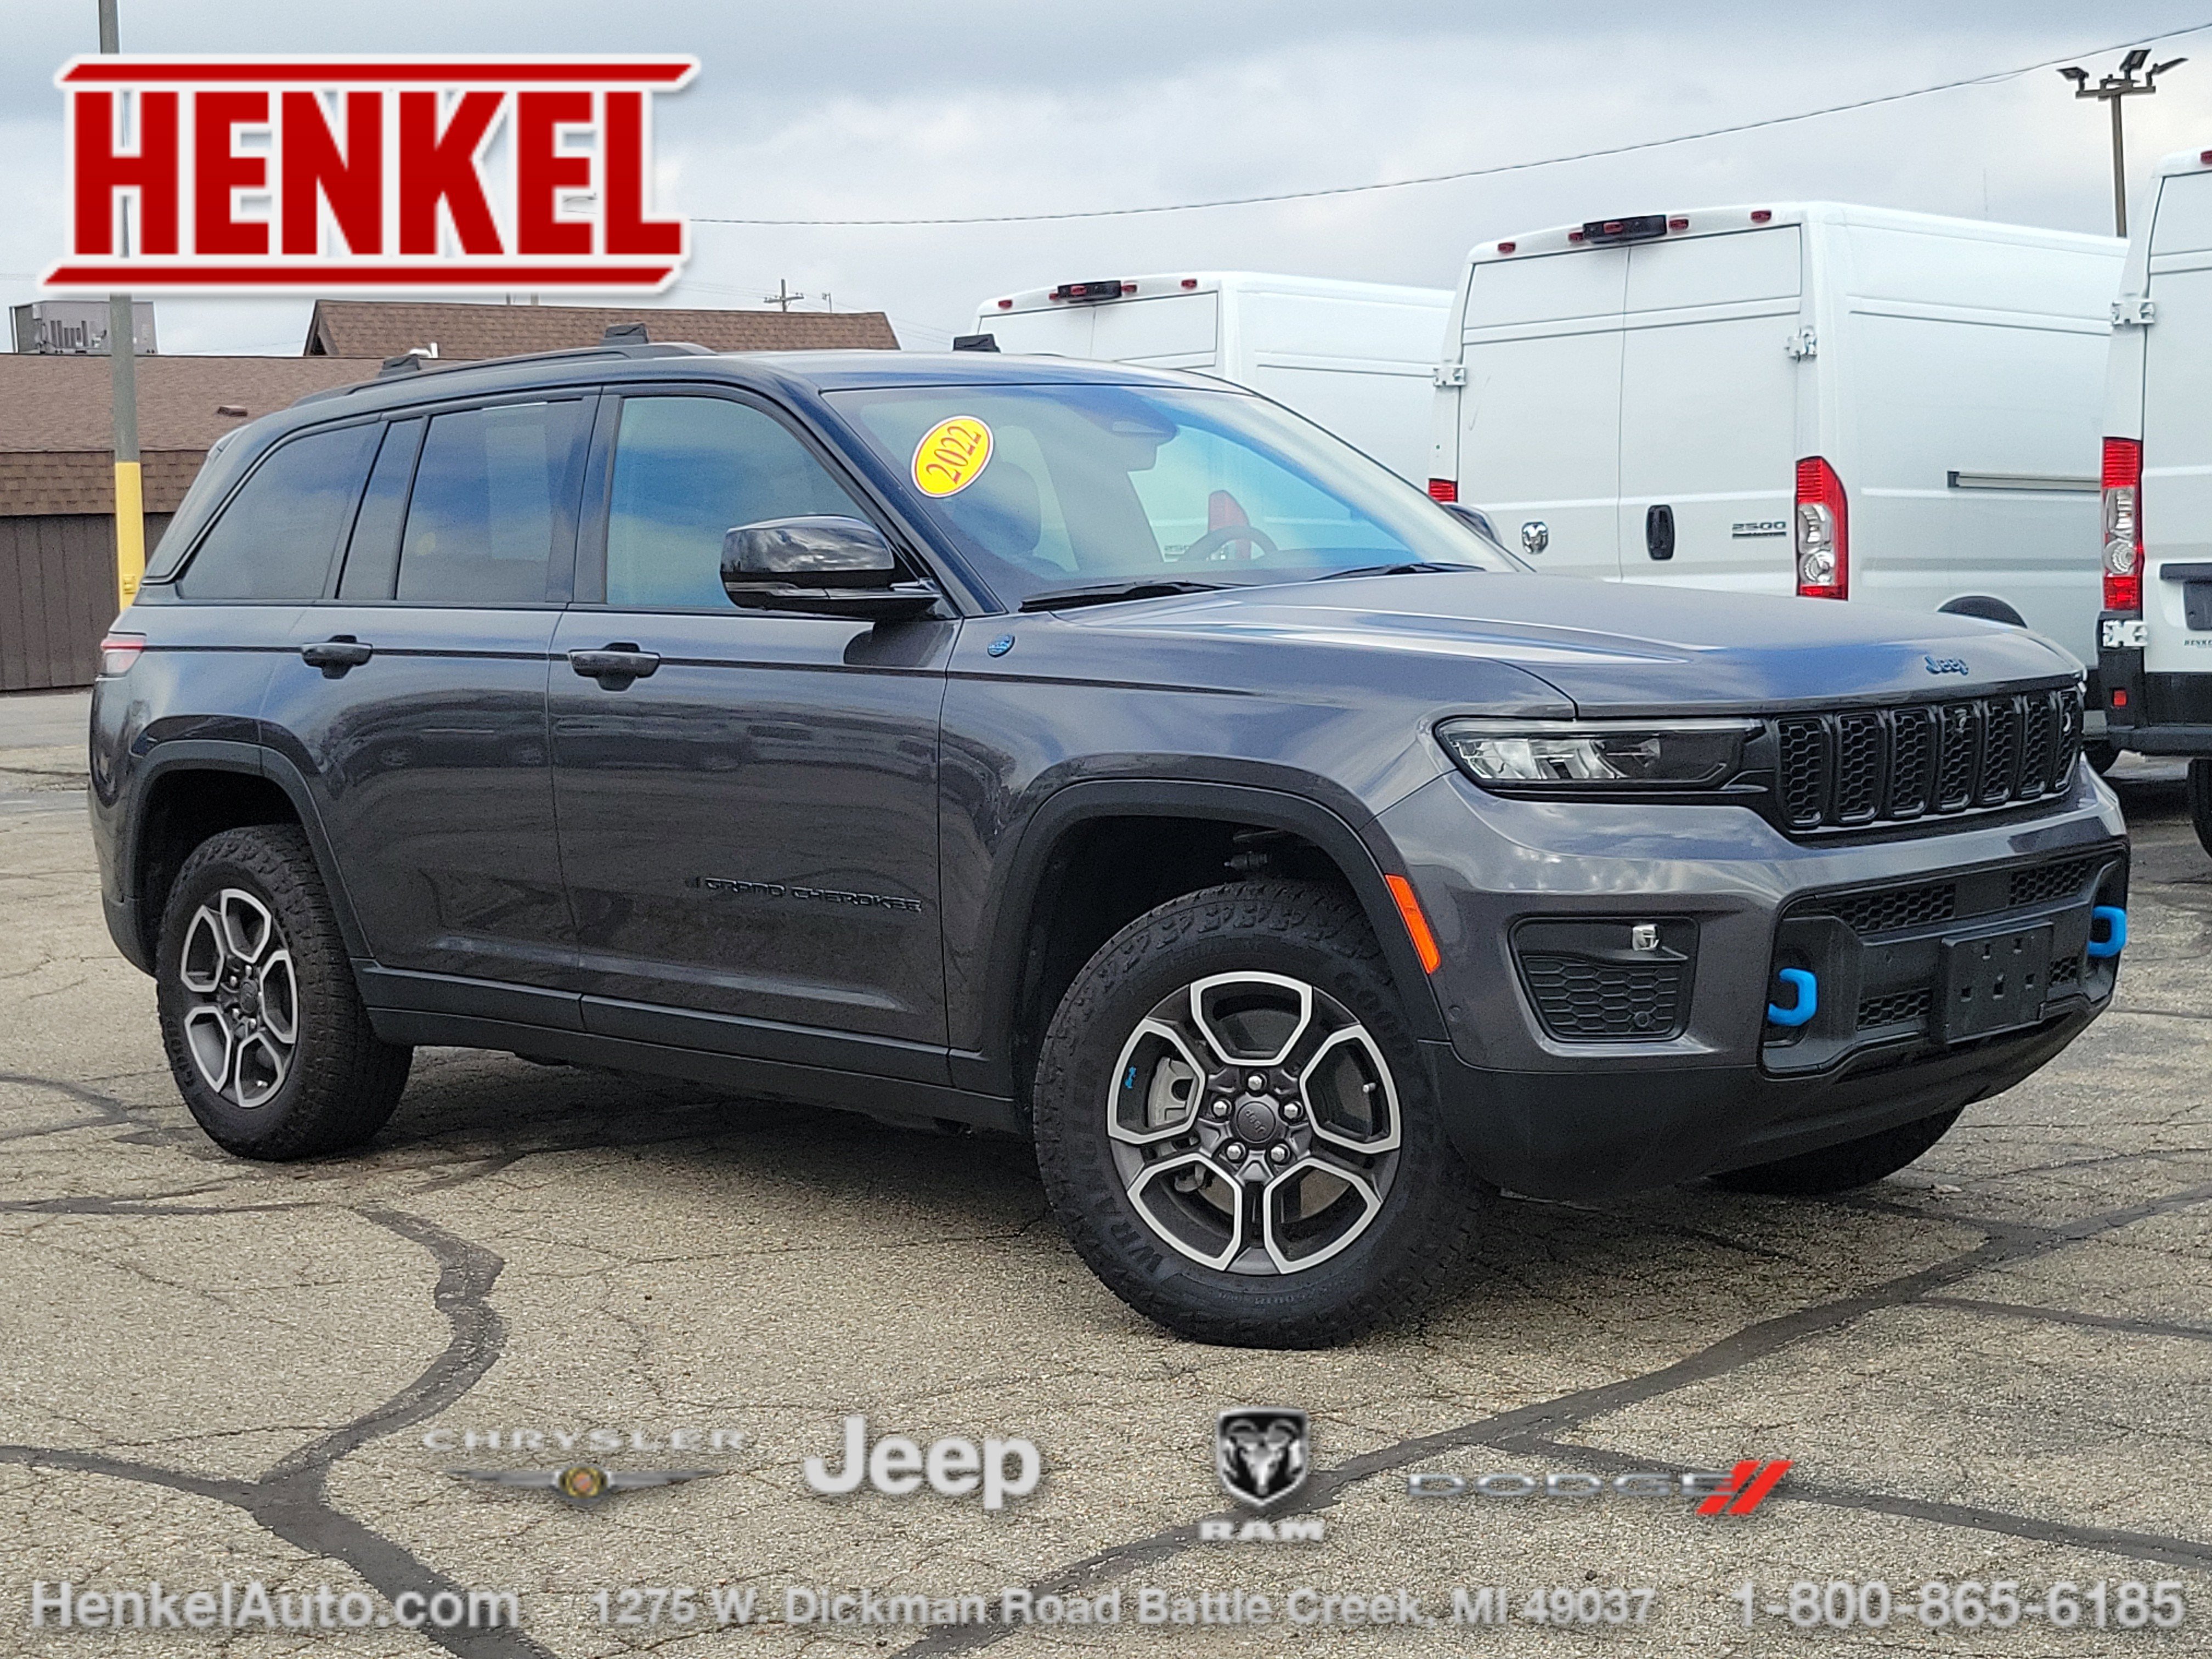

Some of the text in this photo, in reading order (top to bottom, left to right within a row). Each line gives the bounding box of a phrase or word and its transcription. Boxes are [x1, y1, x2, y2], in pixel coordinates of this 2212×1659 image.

[926, 426, 982, 484] 2022
[1731, 522, 1787, 532] 2500
[1924, 655, 1969, 676] Jeep
[791, 886, 922, 912] CHEROKEE
